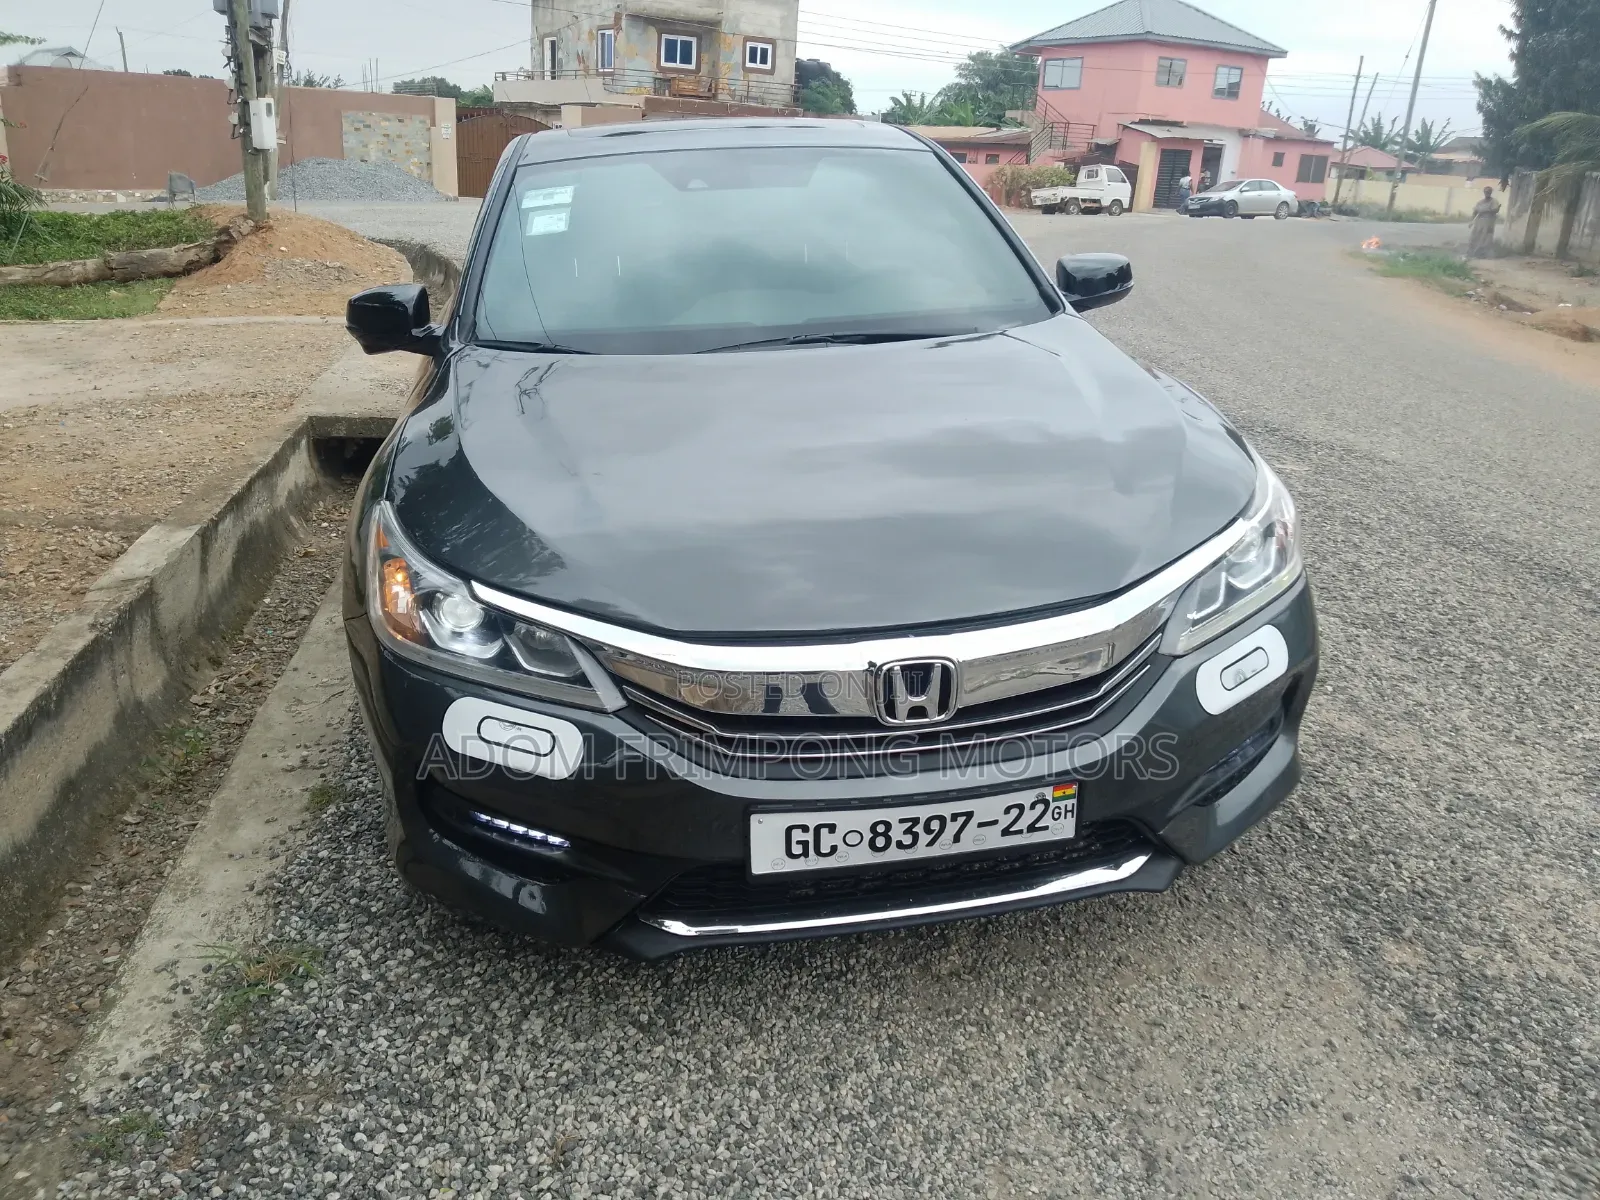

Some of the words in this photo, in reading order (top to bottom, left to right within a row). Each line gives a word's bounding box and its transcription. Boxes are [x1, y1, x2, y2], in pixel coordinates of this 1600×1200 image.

[784, 823, 839, 860] GC
[868, 798, 1051, 853] 8397-22
[1051, 802, 1075, 822] GH
